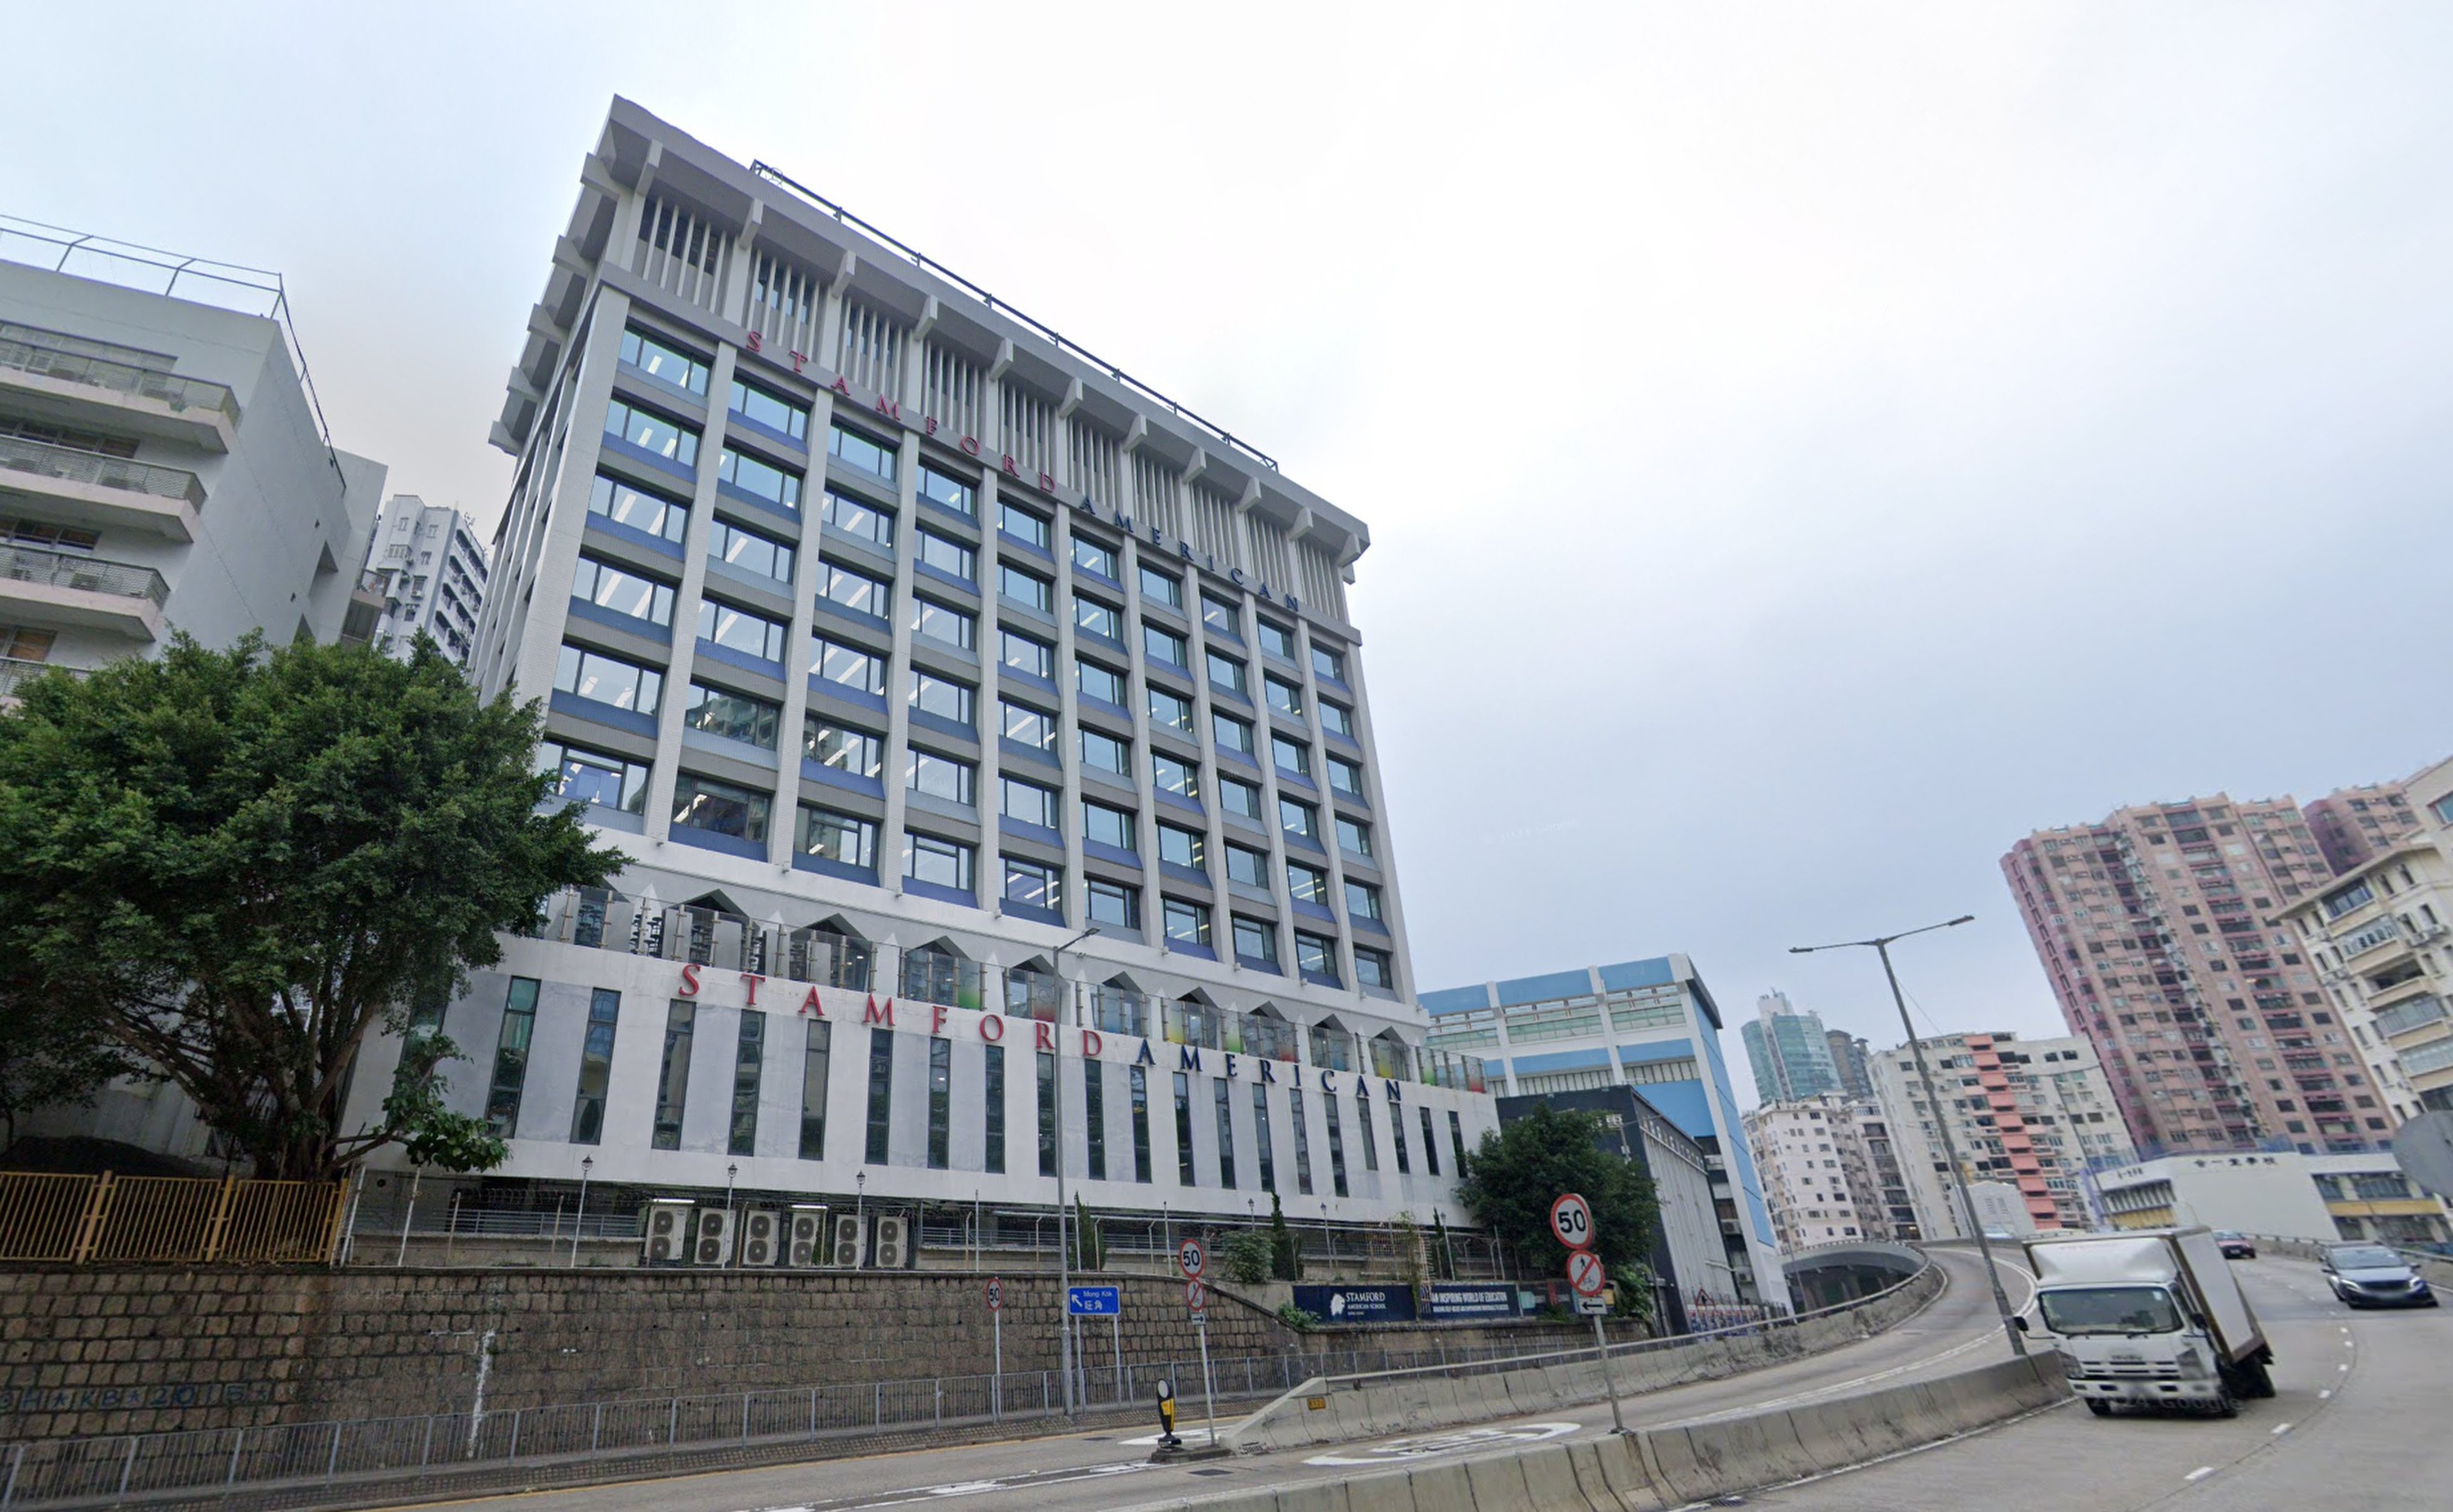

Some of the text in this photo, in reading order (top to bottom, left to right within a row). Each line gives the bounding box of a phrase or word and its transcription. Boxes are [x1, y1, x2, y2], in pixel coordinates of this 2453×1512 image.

[746, 330, 1299, 613] STAMFORD AMERICAN
[679, 963, 1402, 1102] STAMFORD AMERICAN
[1557, 1209, 1586, 1233] 50
[1183, 1250, 1200, 1266] 50
[989, 1287, 1000, 1301] 50
[1345, 1292, 1386, 1302] STAMFORD
